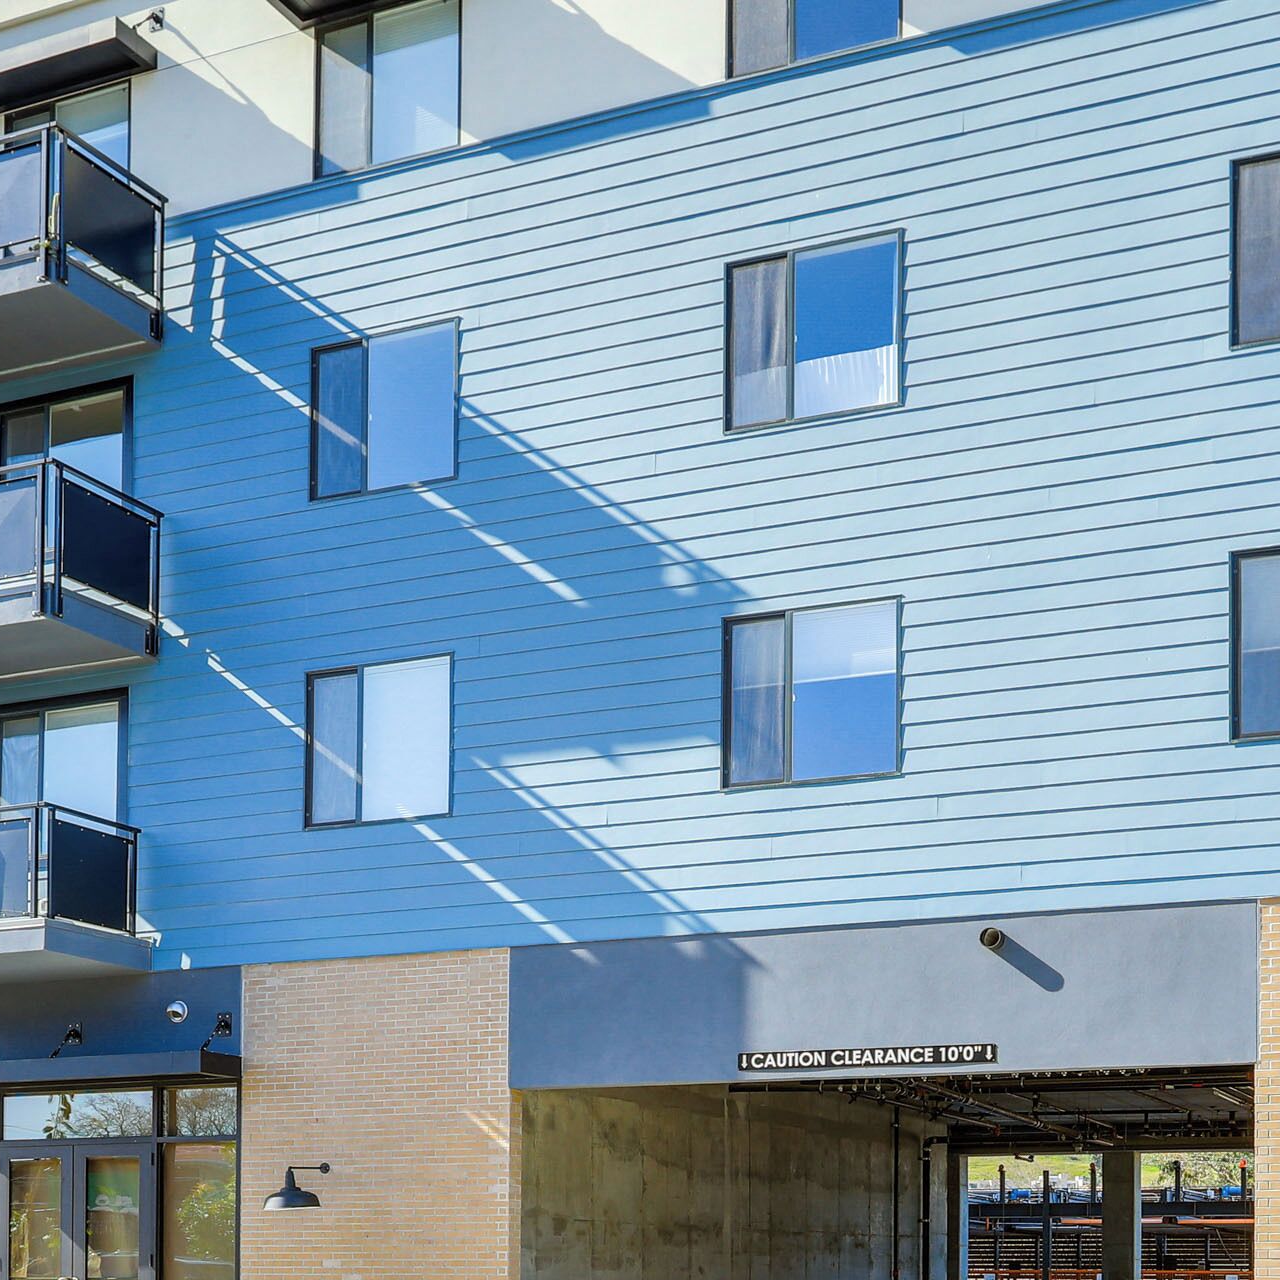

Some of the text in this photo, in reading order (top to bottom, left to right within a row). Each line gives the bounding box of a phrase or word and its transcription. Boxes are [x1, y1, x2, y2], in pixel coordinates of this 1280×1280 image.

[751, 1046, 982, 1069] CAUTION CLEARANCE 10'0"
